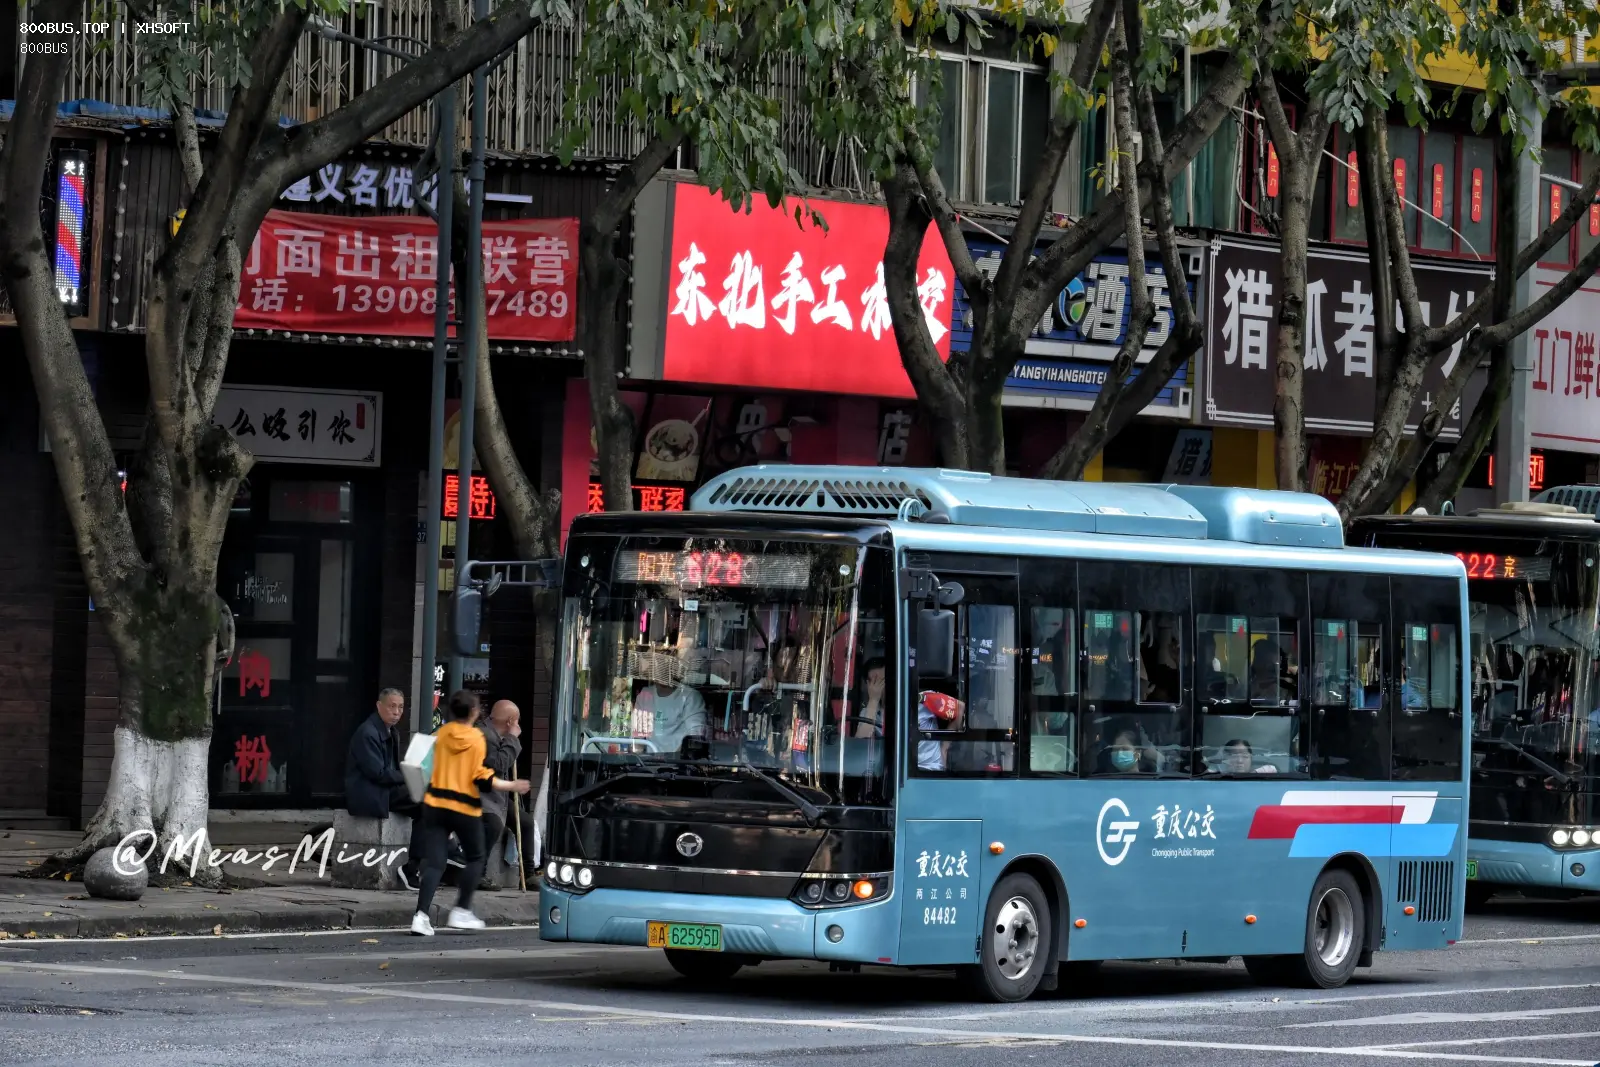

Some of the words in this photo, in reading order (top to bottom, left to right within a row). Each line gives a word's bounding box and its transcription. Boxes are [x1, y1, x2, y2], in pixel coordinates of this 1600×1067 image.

[332, 284, 568, 318] 139087489
[637, 551, 677, 582] 阳光
[687, 551, 743, 585] 628
[1455, 552, 1497, 578] 22
[1151, 804, 1217, 840] 重庆公交
[915, 850, 970, 878] 重庆公交
[1151, 847, 1177, 859] Chongqing
[1178, 847, 1192, 857] Public
[1193, 847, 1215, 858] Transport
[915, 887, 967, 900] 两江公司
[923, 907, 957, 925] 84482
